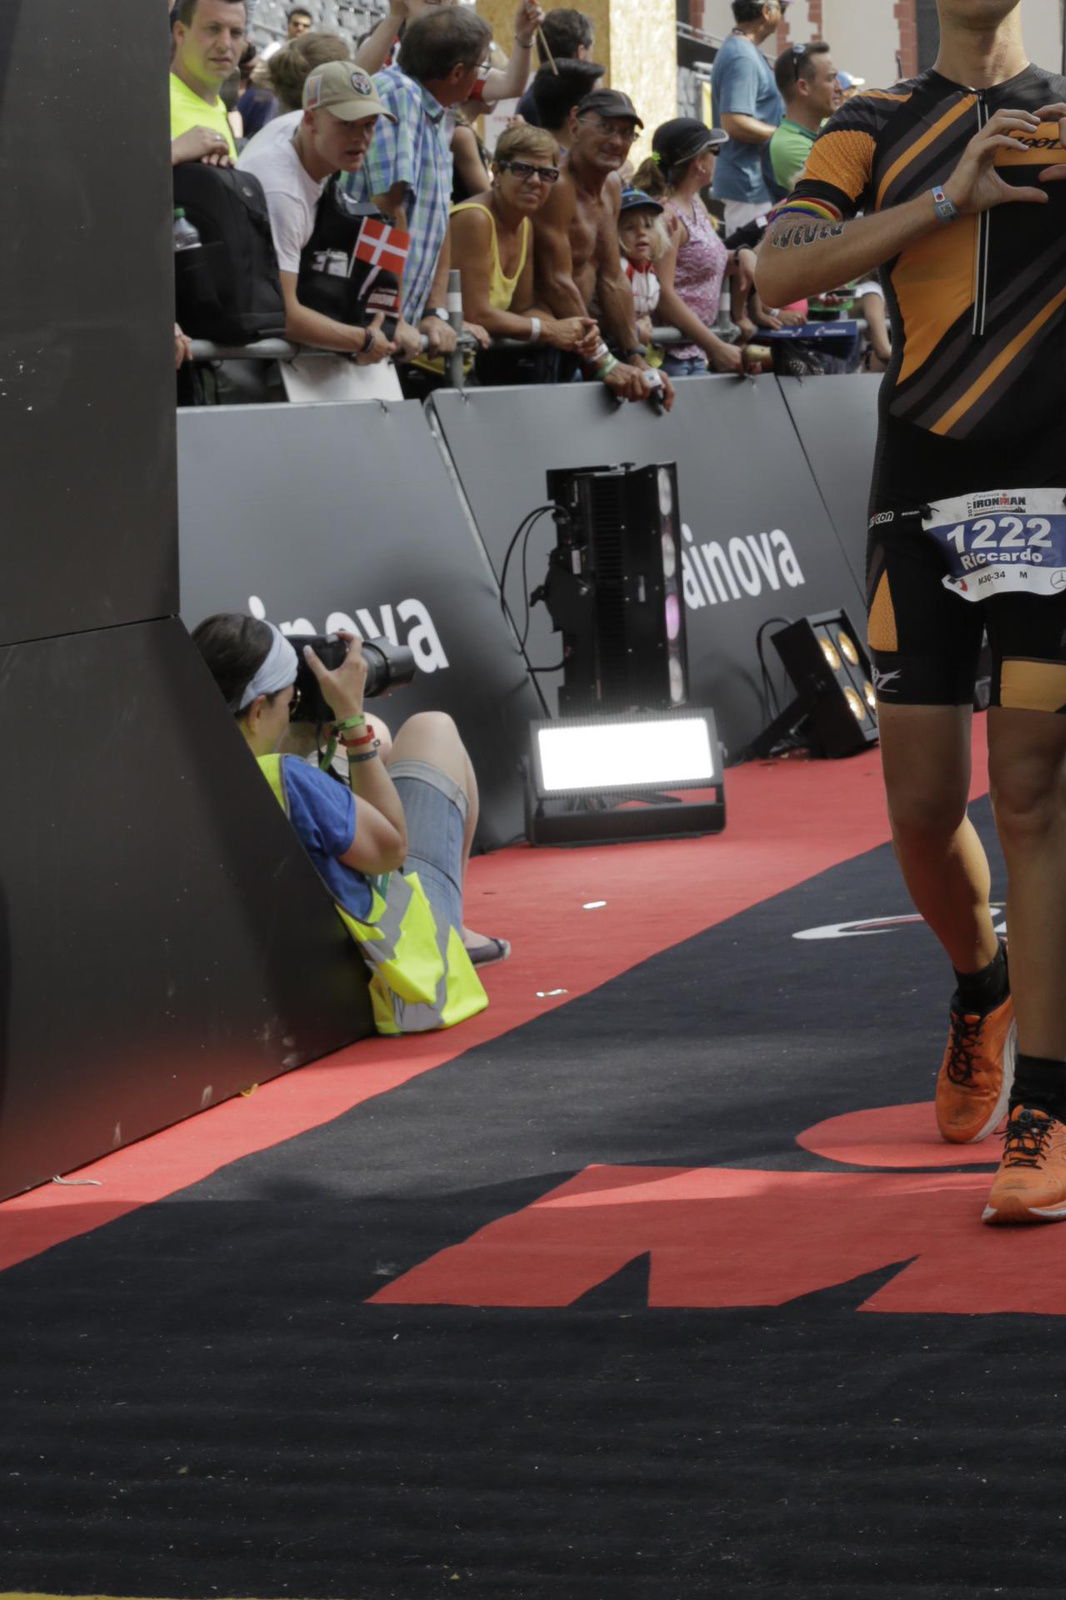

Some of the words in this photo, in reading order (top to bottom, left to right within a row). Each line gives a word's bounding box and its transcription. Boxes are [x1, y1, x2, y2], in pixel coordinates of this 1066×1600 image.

[973, 492, 1027, 509] IRONMAN
[946, 516, 1053, 555] 1222
[959, 547, 1044, 571] Riccardo
[977, 570, 1007, 586] M30-34
[1019, 571, 1028, 580] M
